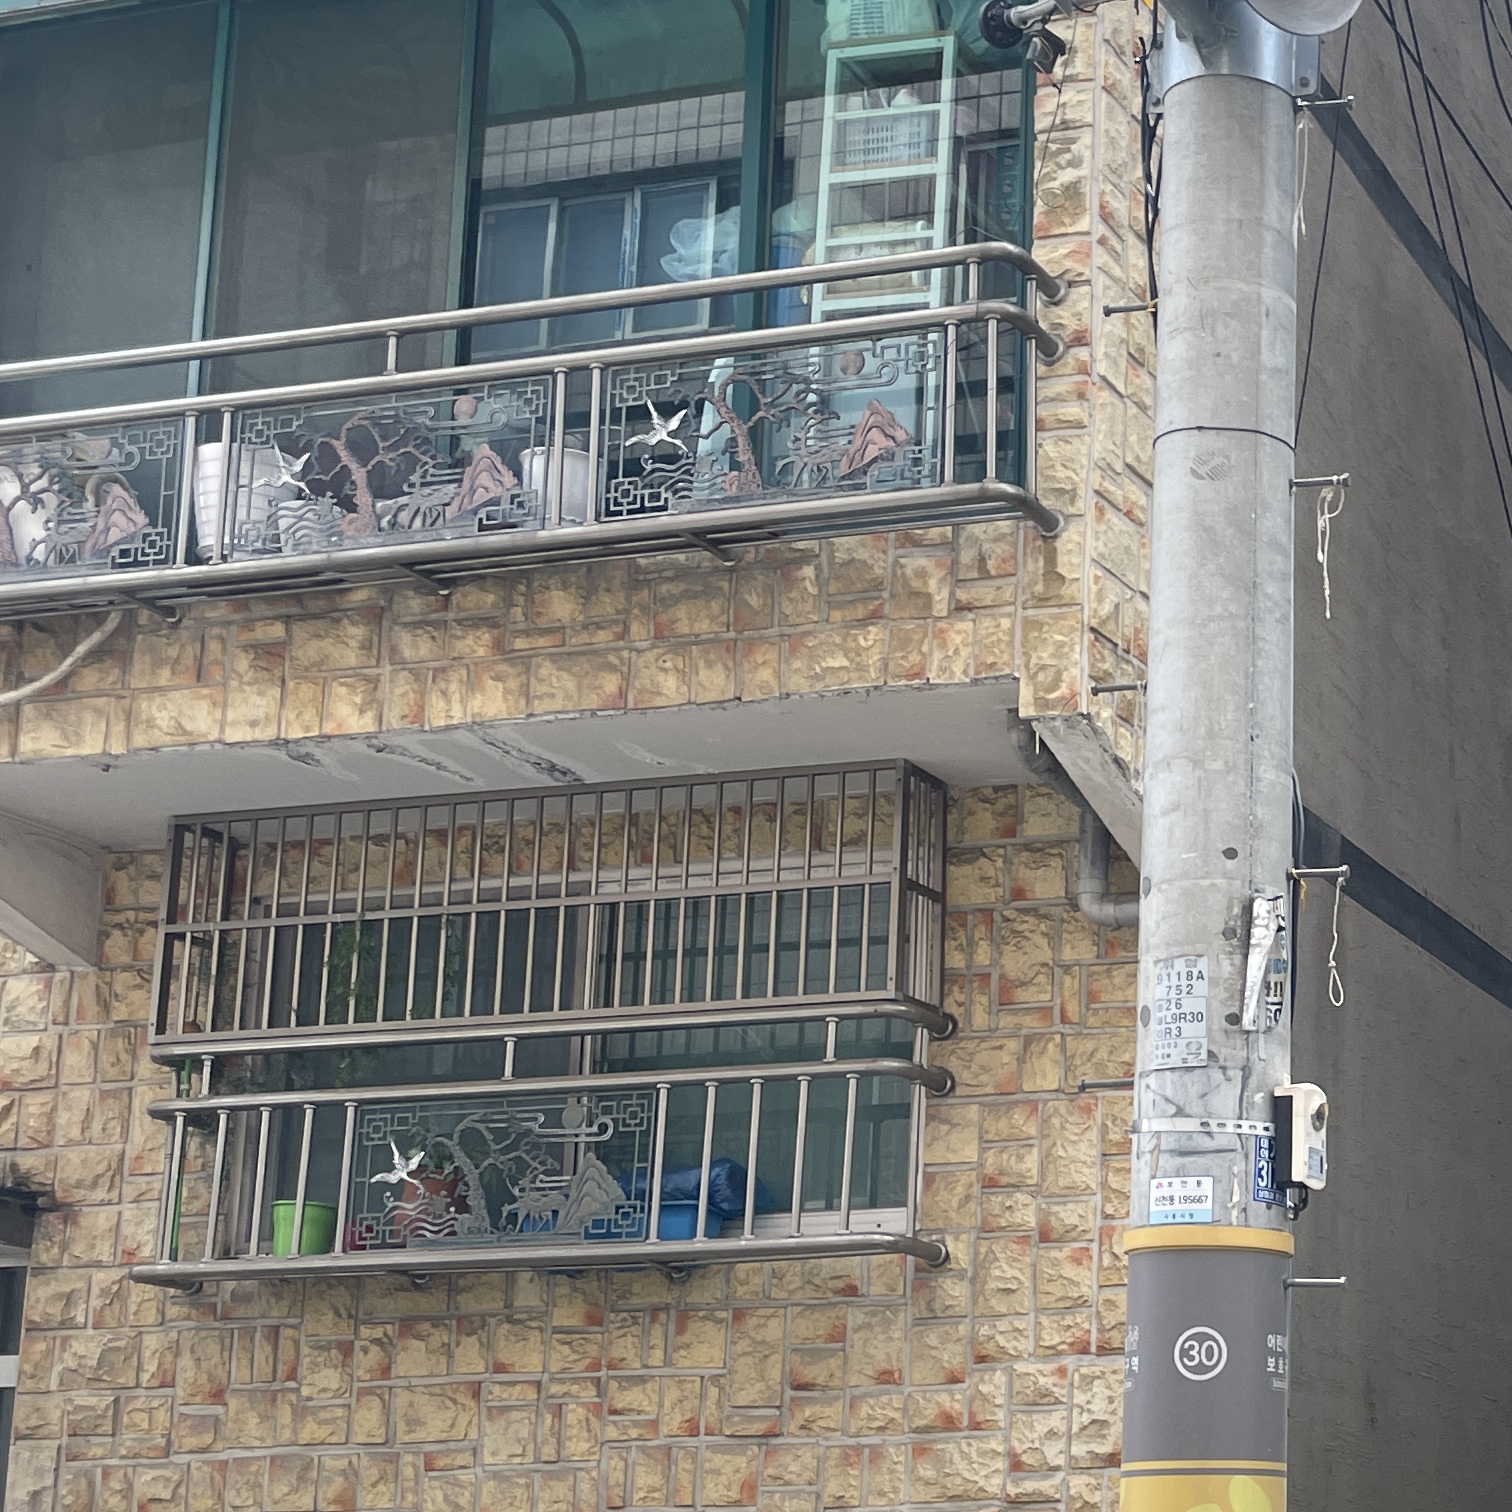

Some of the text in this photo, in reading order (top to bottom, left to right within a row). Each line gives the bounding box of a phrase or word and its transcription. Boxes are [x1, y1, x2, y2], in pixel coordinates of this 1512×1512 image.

[1165, 983, 1194, 998] 752
[1164, 1011, 1204, 1026] L9R30
[1182, 1340, 1219, 1367] 30
